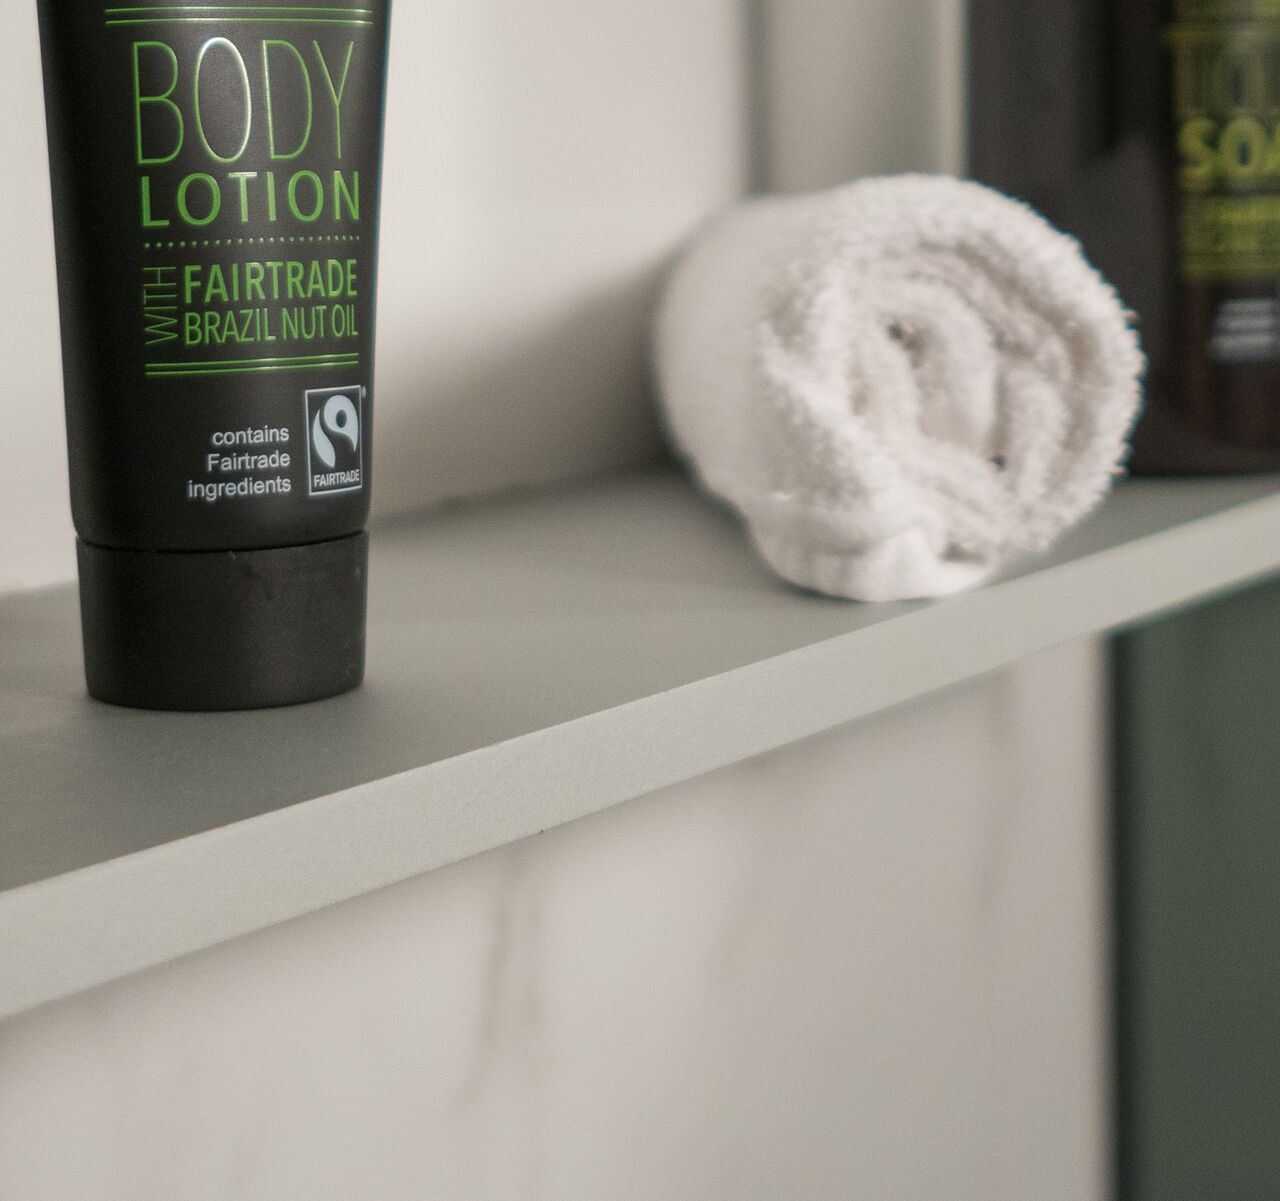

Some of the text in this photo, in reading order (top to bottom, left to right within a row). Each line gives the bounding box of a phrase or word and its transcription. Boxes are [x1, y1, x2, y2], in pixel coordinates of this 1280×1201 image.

[132, 36, 354, 164] BODY
[141, 170, 359, 226] LOTION
[184, 259, 357, 304] FAIRTRADE
[143, 266, 178, 344] WITH
[184, 304, 358, 344] BRAZIL NUT OIL
[212, 425, 290, 445] contains
[207, 450, 291, 471] Fairtrade
[314, 469, 360, 487] FAIRTRADE
[188, 475, 292, 502] ingredients
